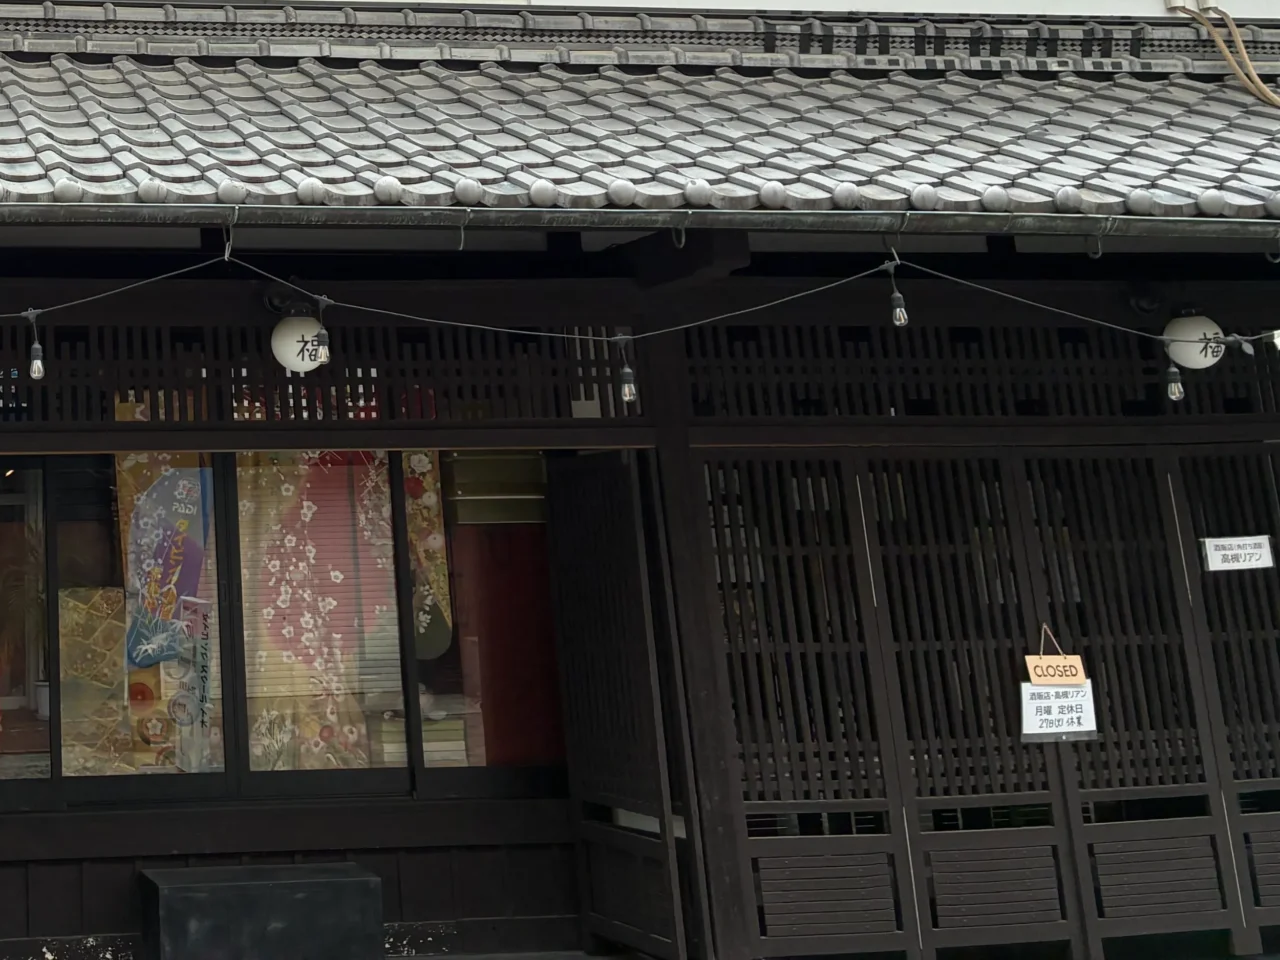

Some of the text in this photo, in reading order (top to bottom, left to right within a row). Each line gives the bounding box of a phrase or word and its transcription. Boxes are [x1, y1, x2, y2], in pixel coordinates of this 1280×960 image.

[296, 333, 319, 362] 福
[1198, 332, 1223, 358] 福
[1220, 552, 1262, 564] 高槻リアン
[1033, 664, 1078, 678] CLOSED
[1035, 704, 1084, 716] 月曜 定休日
